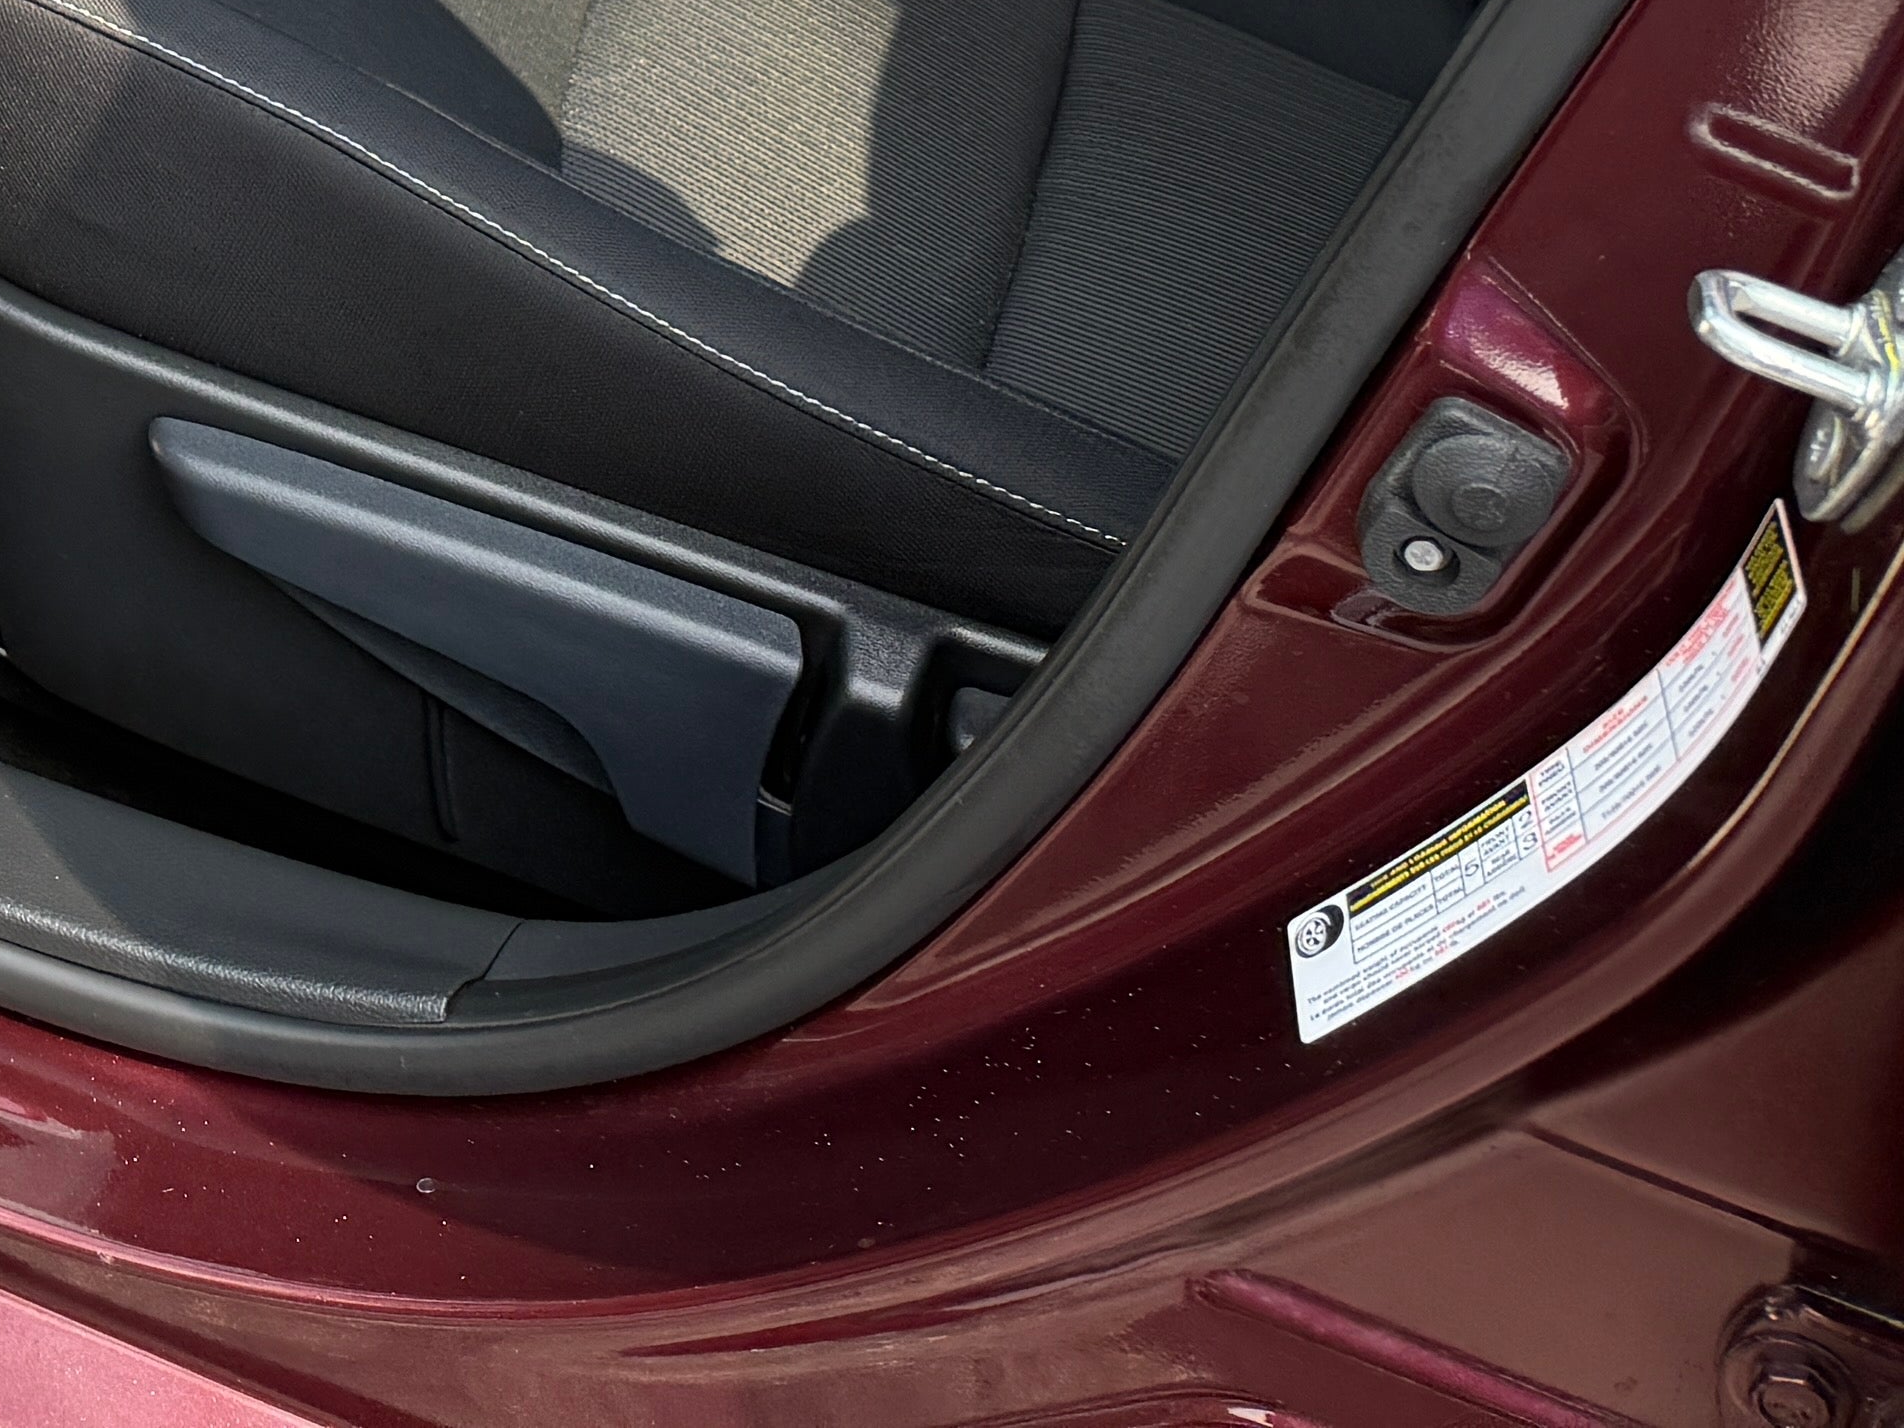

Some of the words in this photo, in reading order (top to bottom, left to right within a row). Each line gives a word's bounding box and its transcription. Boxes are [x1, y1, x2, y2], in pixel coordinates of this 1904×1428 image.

[1518, 810, 1533, 829] 2
[1522, 832, 1538, 850] 3
[1464, 858, 1480, 877] 5
